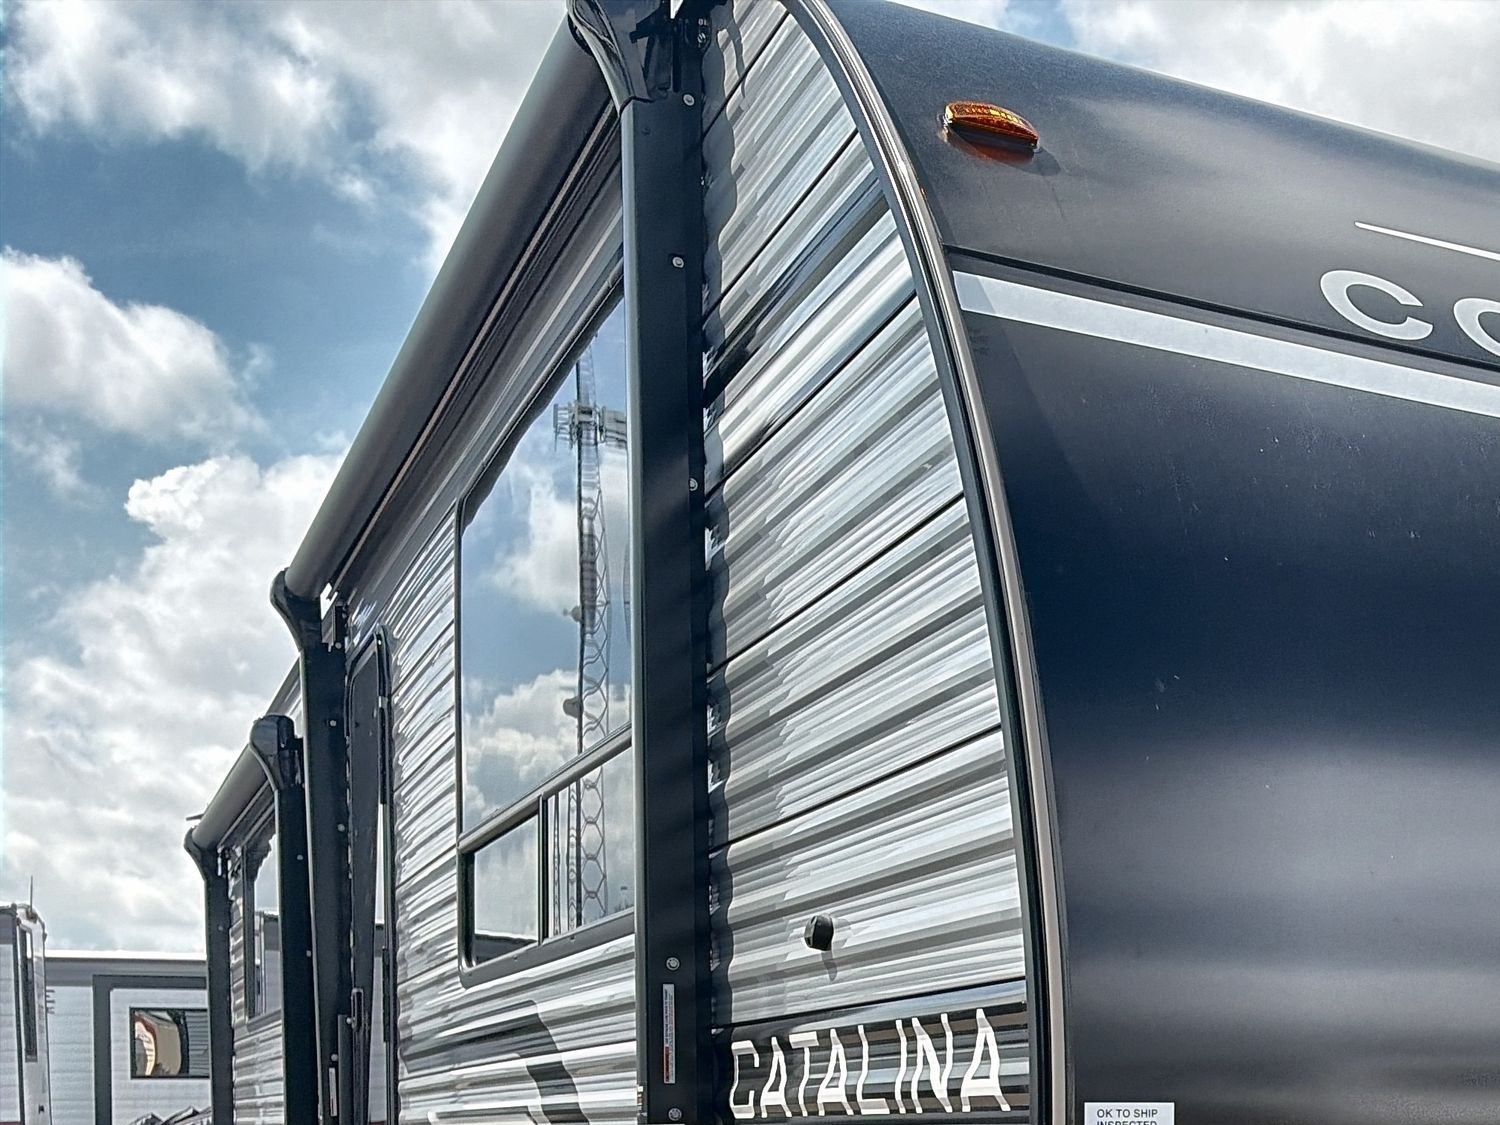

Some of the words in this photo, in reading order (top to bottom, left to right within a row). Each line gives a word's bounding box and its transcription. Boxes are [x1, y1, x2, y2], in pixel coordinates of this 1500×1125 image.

[728, 1008, 1012, 1119] CATALINA
[1096, 1108, 1113, 1118] OK
[1115, 1108, 1131, 1118] TO
[1133, 1108, 1158, 1118] SHIP
